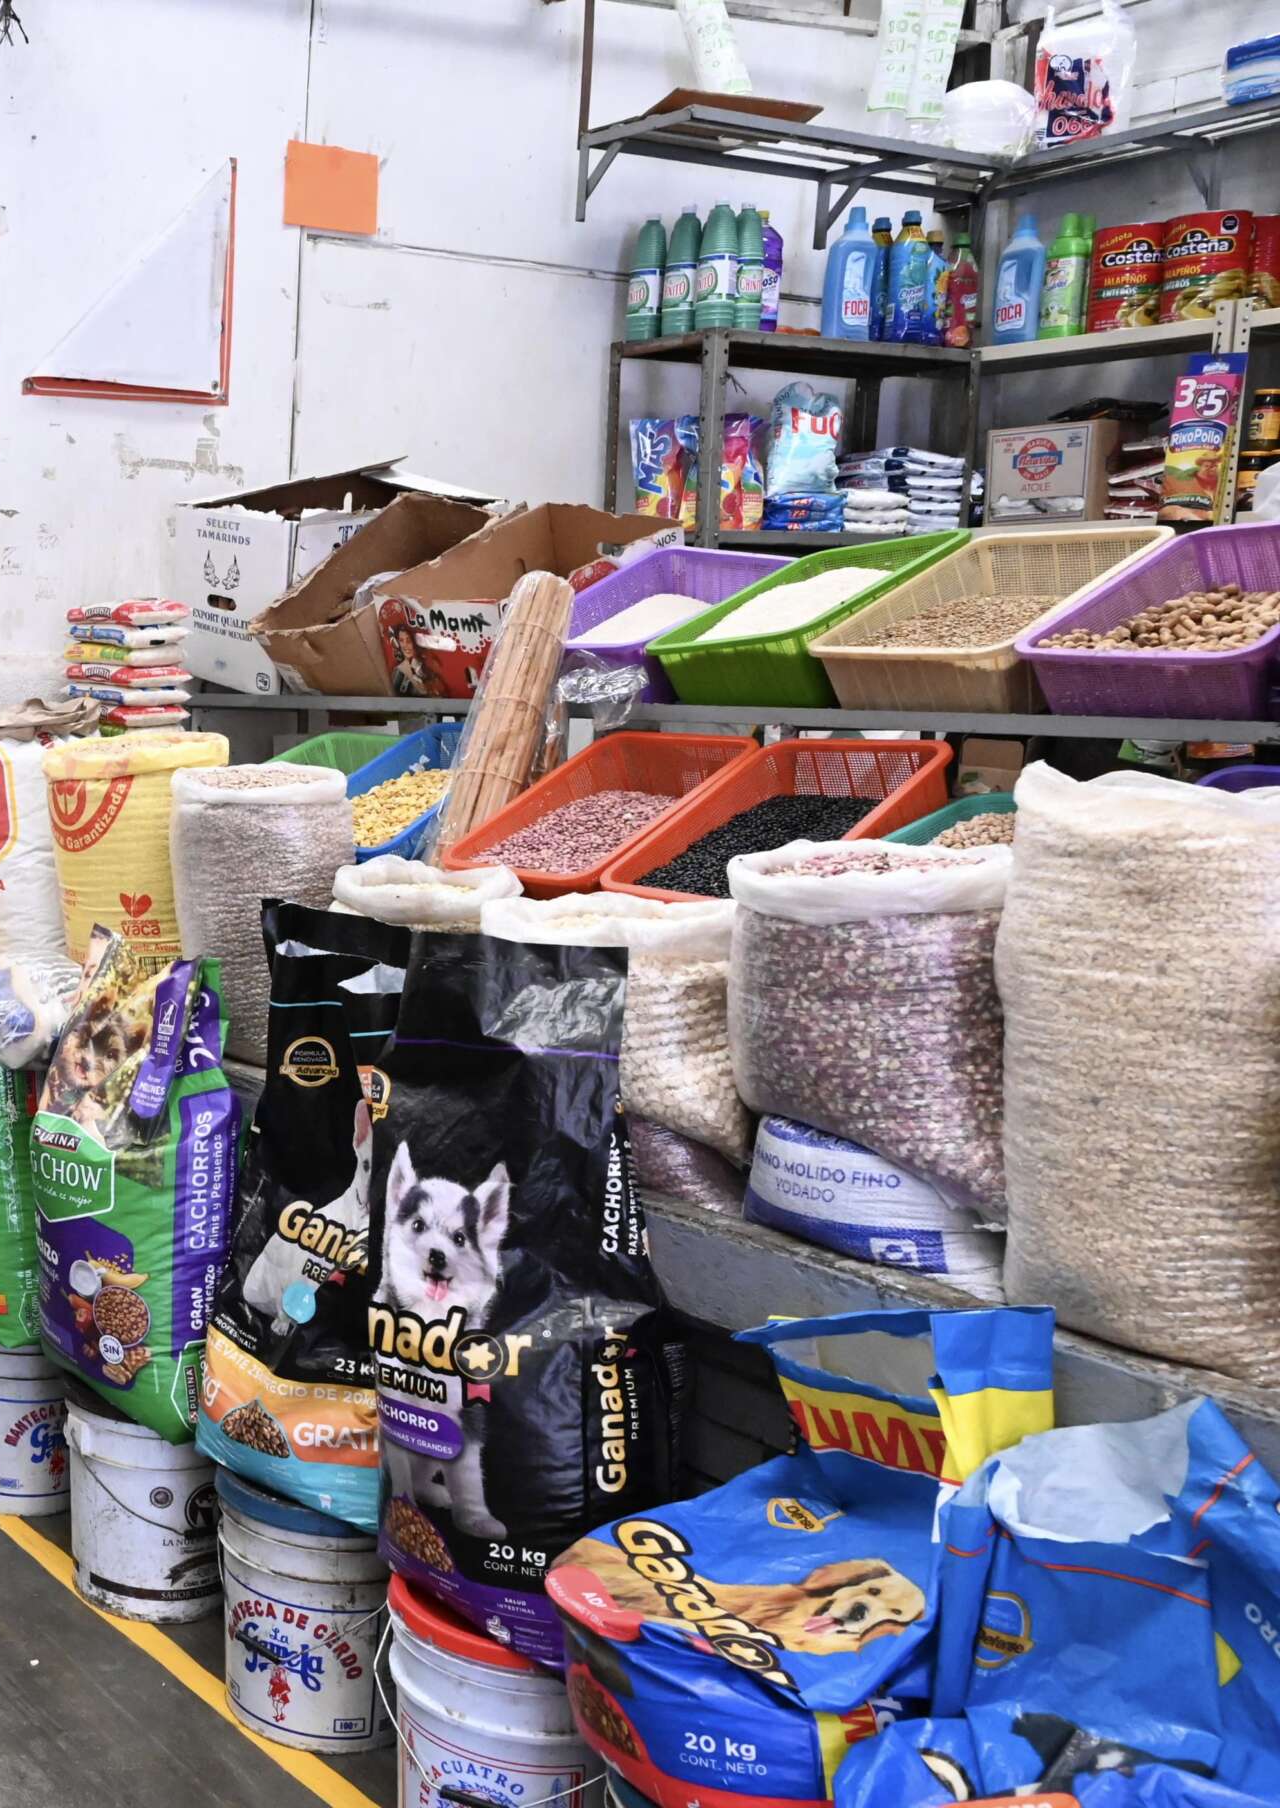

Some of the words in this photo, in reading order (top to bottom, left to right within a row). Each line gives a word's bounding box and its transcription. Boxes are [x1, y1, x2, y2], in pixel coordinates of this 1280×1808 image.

[1132, 241, 1148, 252] La
[844, 300, 868, 316] FOCA
[995, 302, 1022, 324] FOCA
[196, 528, 252, 546] TAMARINDS
[206, 517, 241, 532] SELECT
[192, 607, 220, 625] EXPORT
[220, 614, 251, 632] QUALIT
[121, 924, 161, 937] vaca
[41, 1152, 102, 1191] CHOW
[189, 1110, 213, 1250] CACHORROS
[211, 1133, 223, 1201] Pequeños
[783, 1162, 846, 1184] MOLIDO
[851, 1171, 901, 1190] FINO
[776, 1177, 835, 1203] YODADO
[208, 1211, 220, 1249] Minis
[628, 1217, 638, 1255] RAZAS
[191, 1287, 203, 1330] GRAN
[103, 1343, 120, 1356] SIN
[334, 1358, 356, 1373] 23
[187, 1367, 197, 1409] PURINA
[590, 1325, 630, 1493] Ganador
[624, 1368, 639, 1440] PREMIUM
[416, 1437, 454, 1455] GRANDES
[483, 1560, 519, 1574] CONT.
[488, 1543, 515, 1560] 20
[521, 1547, 547, 1567] kg
[283, 1606, 308, 1631] DE
[684, 1731, 717, 1754] 20
[724, 1737, 757, 1761] kg
[679, 1751, 721, 1772] CONT.
[725, 1758, 768, 1777] NETO
[440, 1760, 525, 1797] CUATRO
